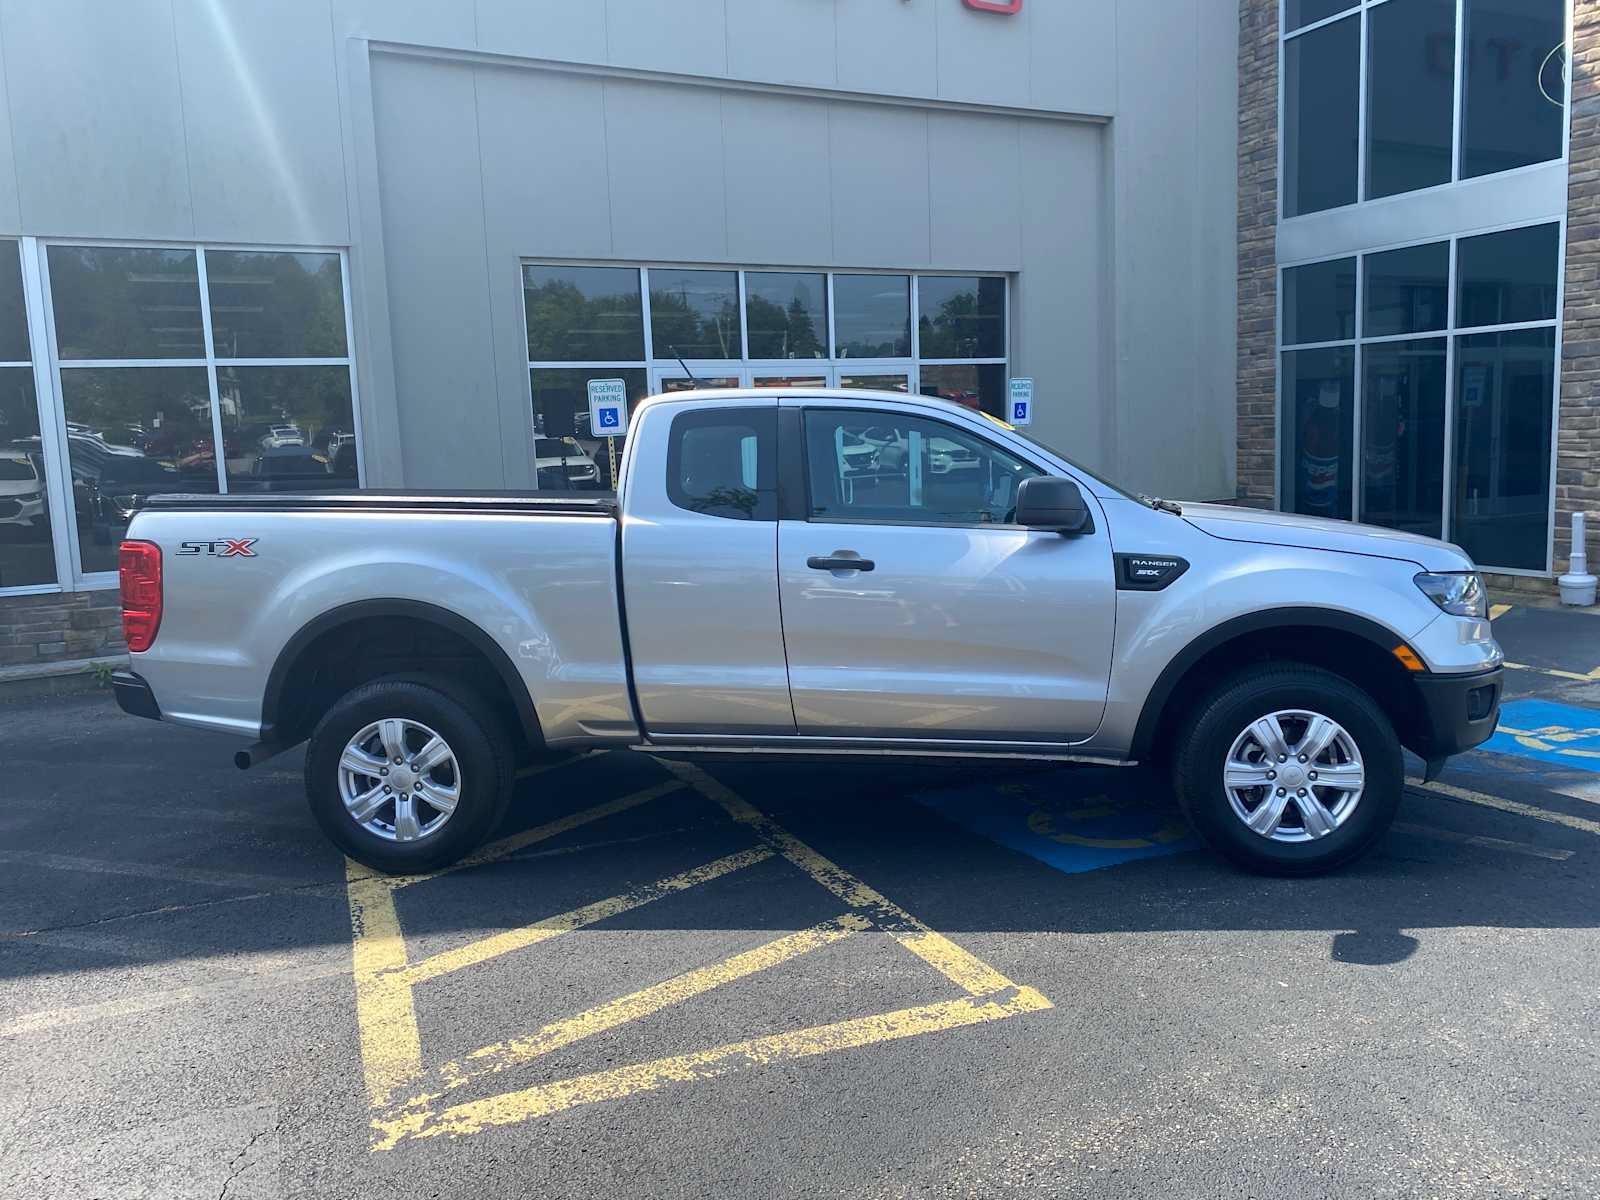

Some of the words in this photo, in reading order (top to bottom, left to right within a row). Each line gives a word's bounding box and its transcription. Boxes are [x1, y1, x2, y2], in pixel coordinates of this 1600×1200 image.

[591, 384, 622, 393] RESERVED
[176, 538, 259, 557] STX
[1132, 559, 1177, 567] RANGER
